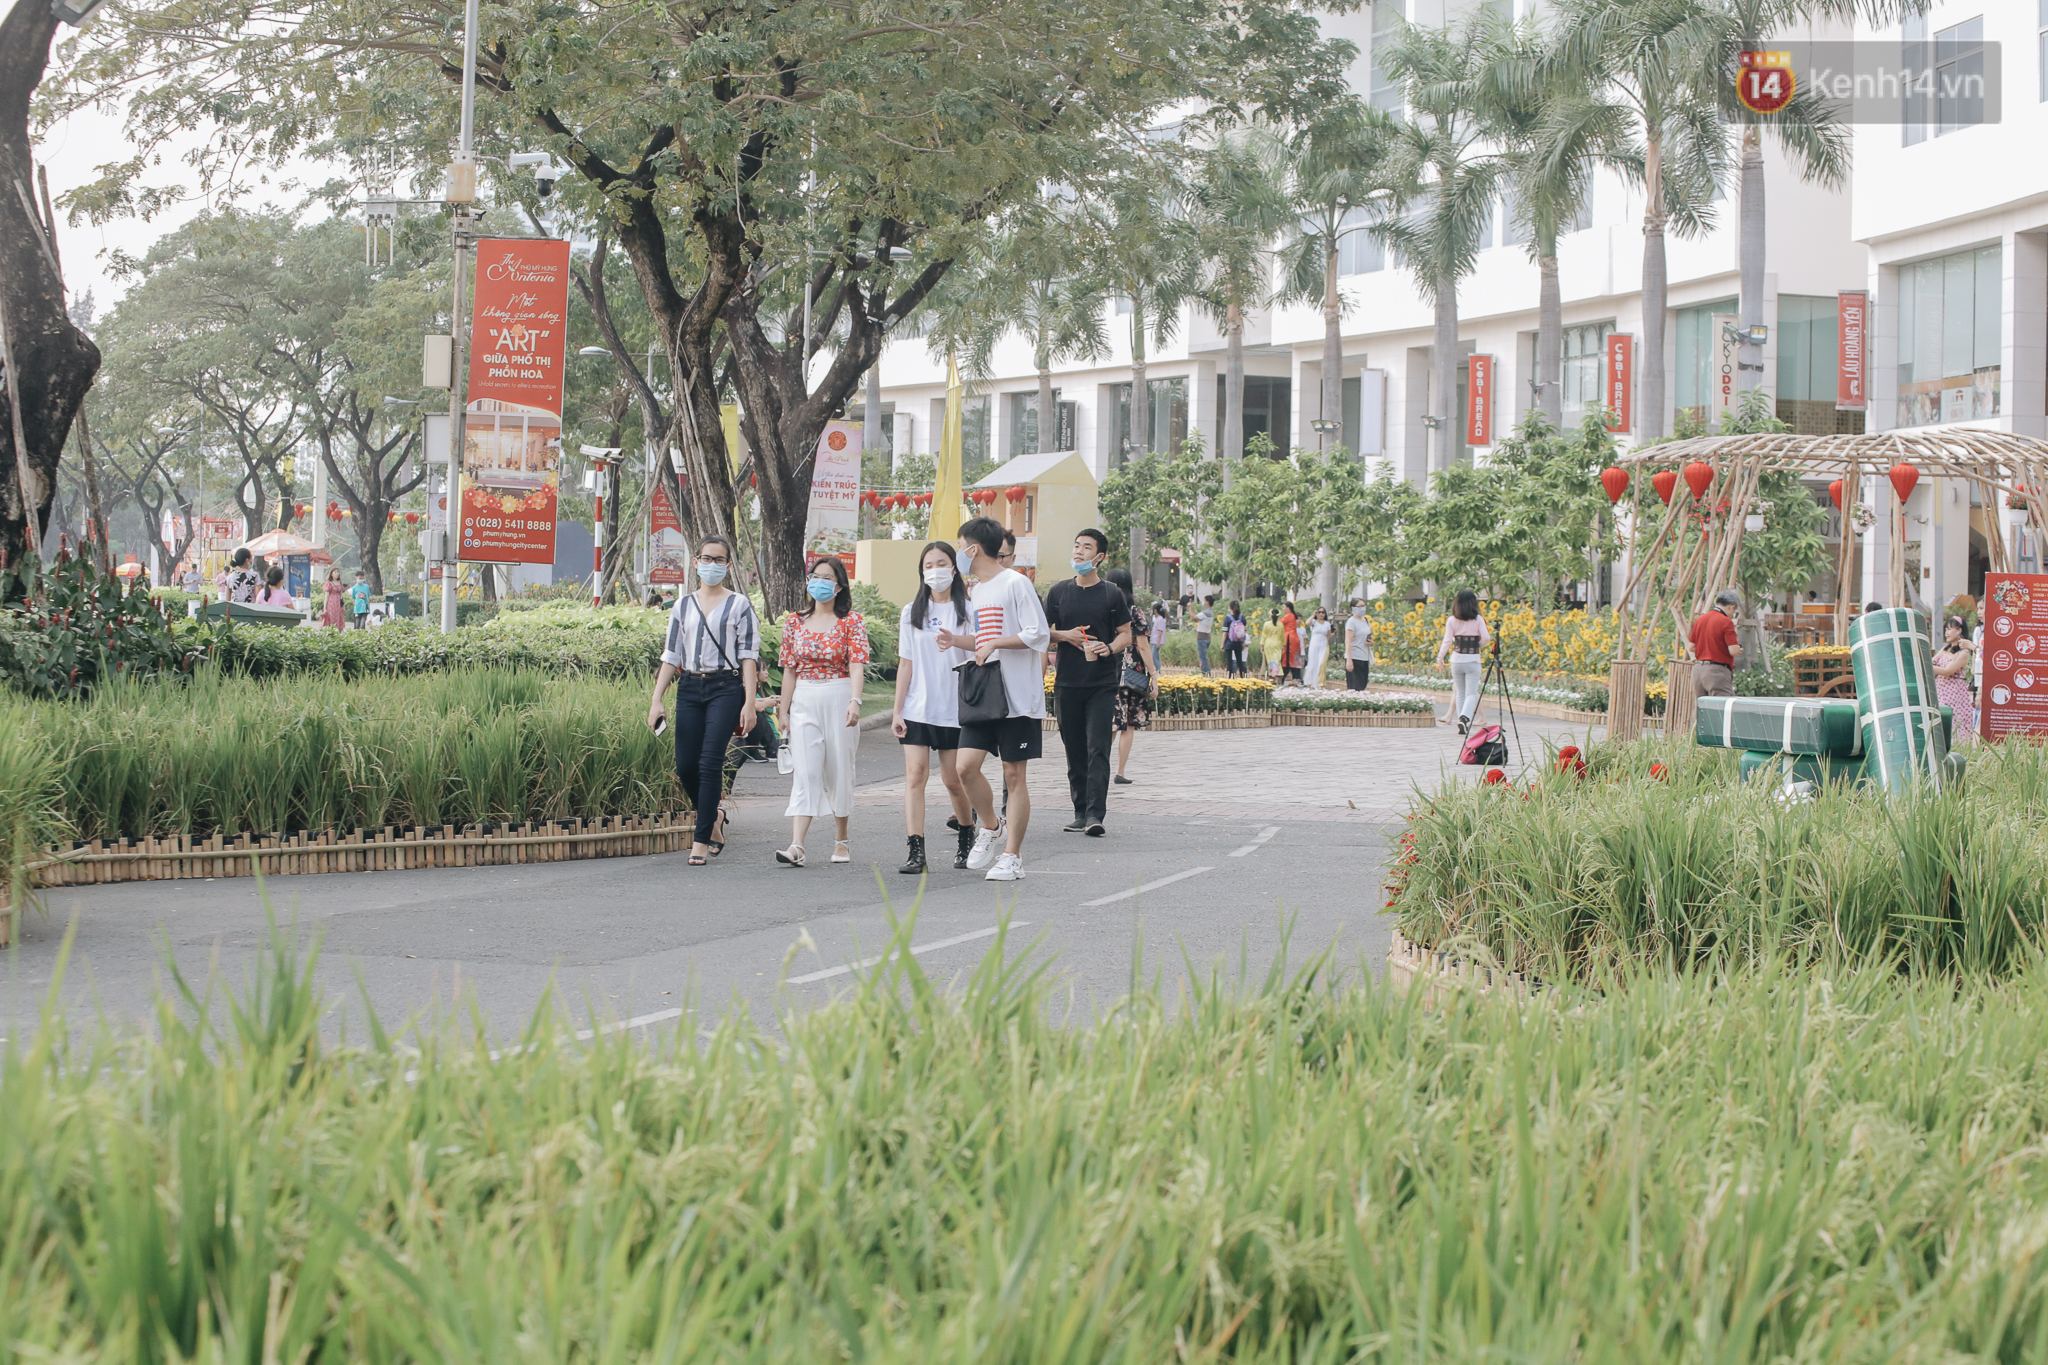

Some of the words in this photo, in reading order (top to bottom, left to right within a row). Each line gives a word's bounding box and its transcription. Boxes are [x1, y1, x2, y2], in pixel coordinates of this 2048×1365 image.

[481, 305, 512, 324] không
[510, 311, 537, 324] gian
[1842, 327, 1860, 358] HOÀNG
[483, 353, 508, 364] GIỮA
[511, 352, 533, 365] PHỐ
[535, 356, 551, 368] THỊ
[1614, 343, 1624, 379] COBI
[520, 369, 543, 380] HOA
[1475, 361, 1484, 395] COBI
[1474, 396, 1484, 437] BREAD
[811, 478, 831, 488] KIẾN
[834, 480, 857, 489] TRÚC
[813, 490, 840, 501] TUYỆT
[842, 491, 855, 500] MỸ
[476, 516, 502, 529] (028)
[505, 519, 524, 529] 5411
[527, 520, 552, 531] 8888
[482, 530, 526, 540] phumyhung.vn
[482, 540, 548, 550] phumyhungcitycenter
